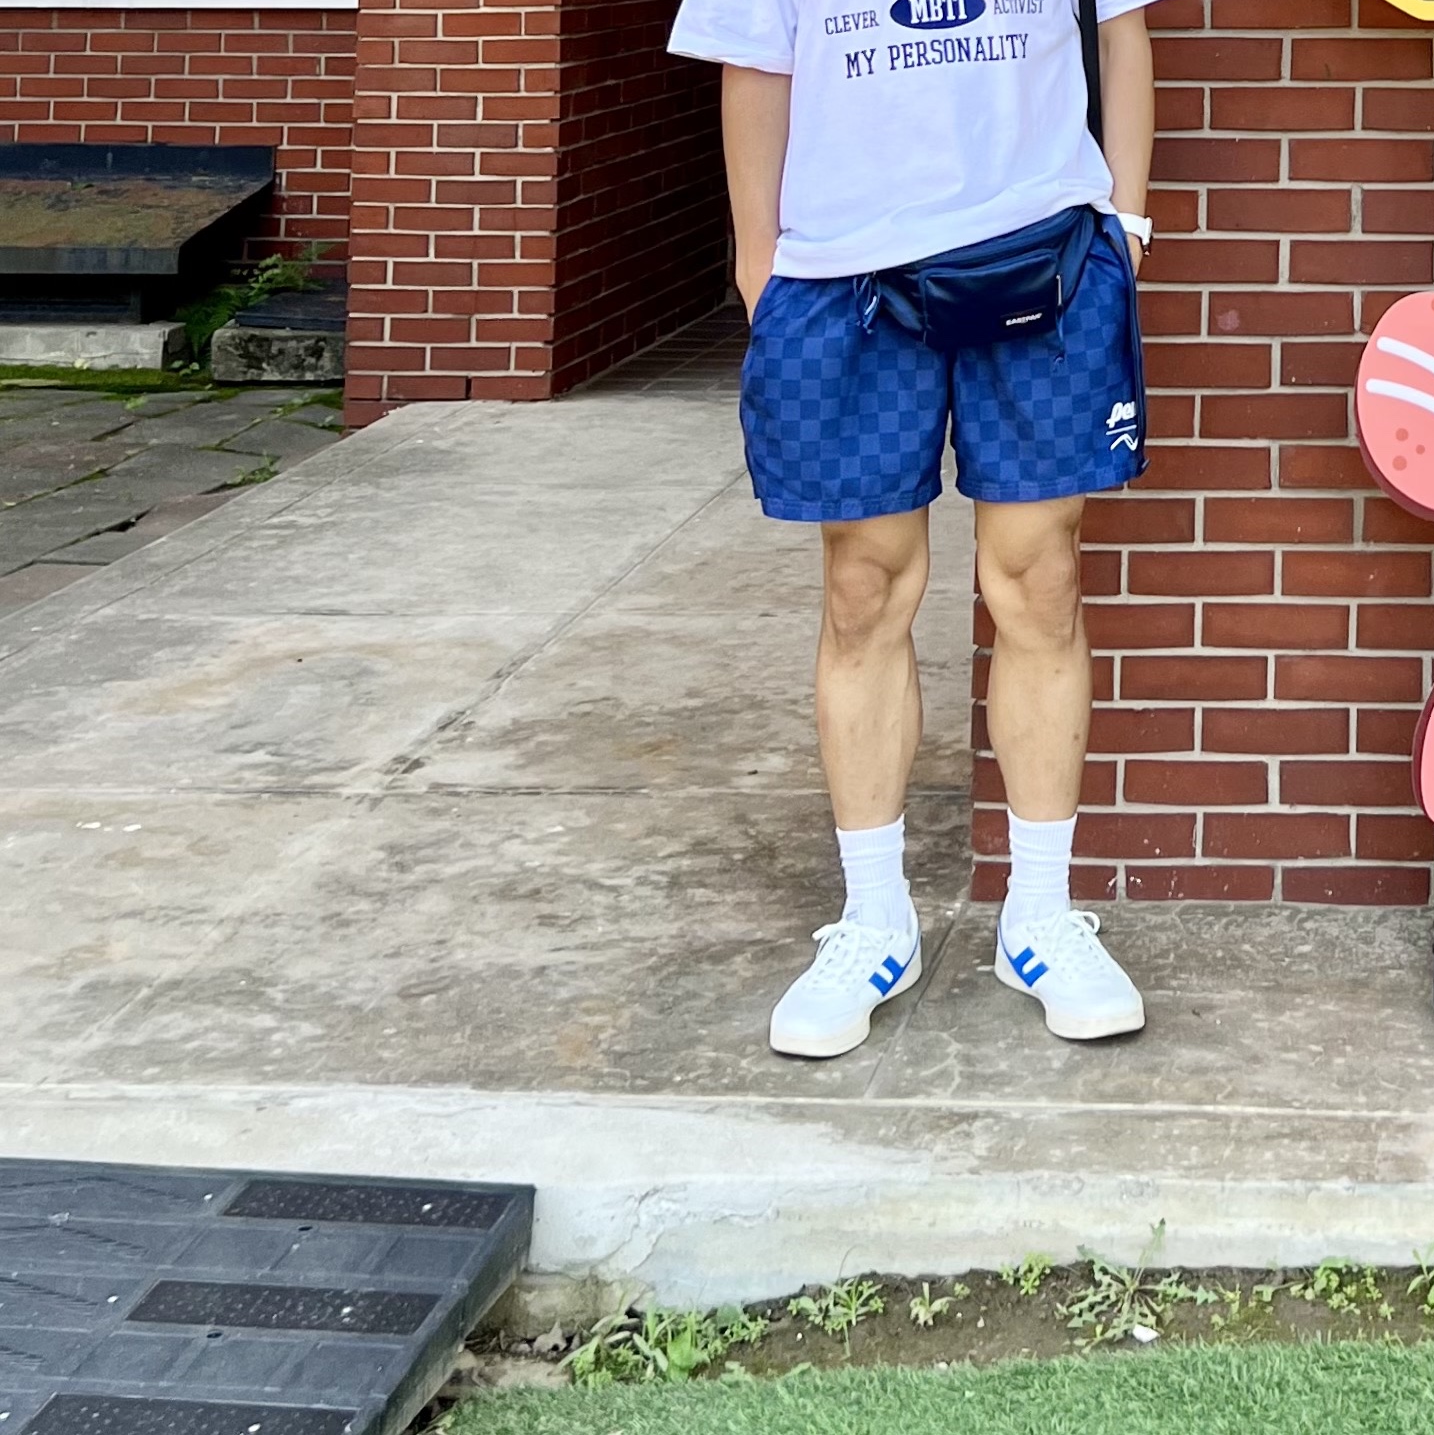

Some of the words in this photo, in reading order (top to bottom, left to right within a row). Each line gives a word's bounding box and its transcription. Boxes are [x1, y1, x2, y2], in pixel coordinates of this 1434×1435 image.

[824, 9, 880, 36] CLEVER
[845, 48, 877, 79] MY
[886, 32, 1030, 71] PERSONALITY
